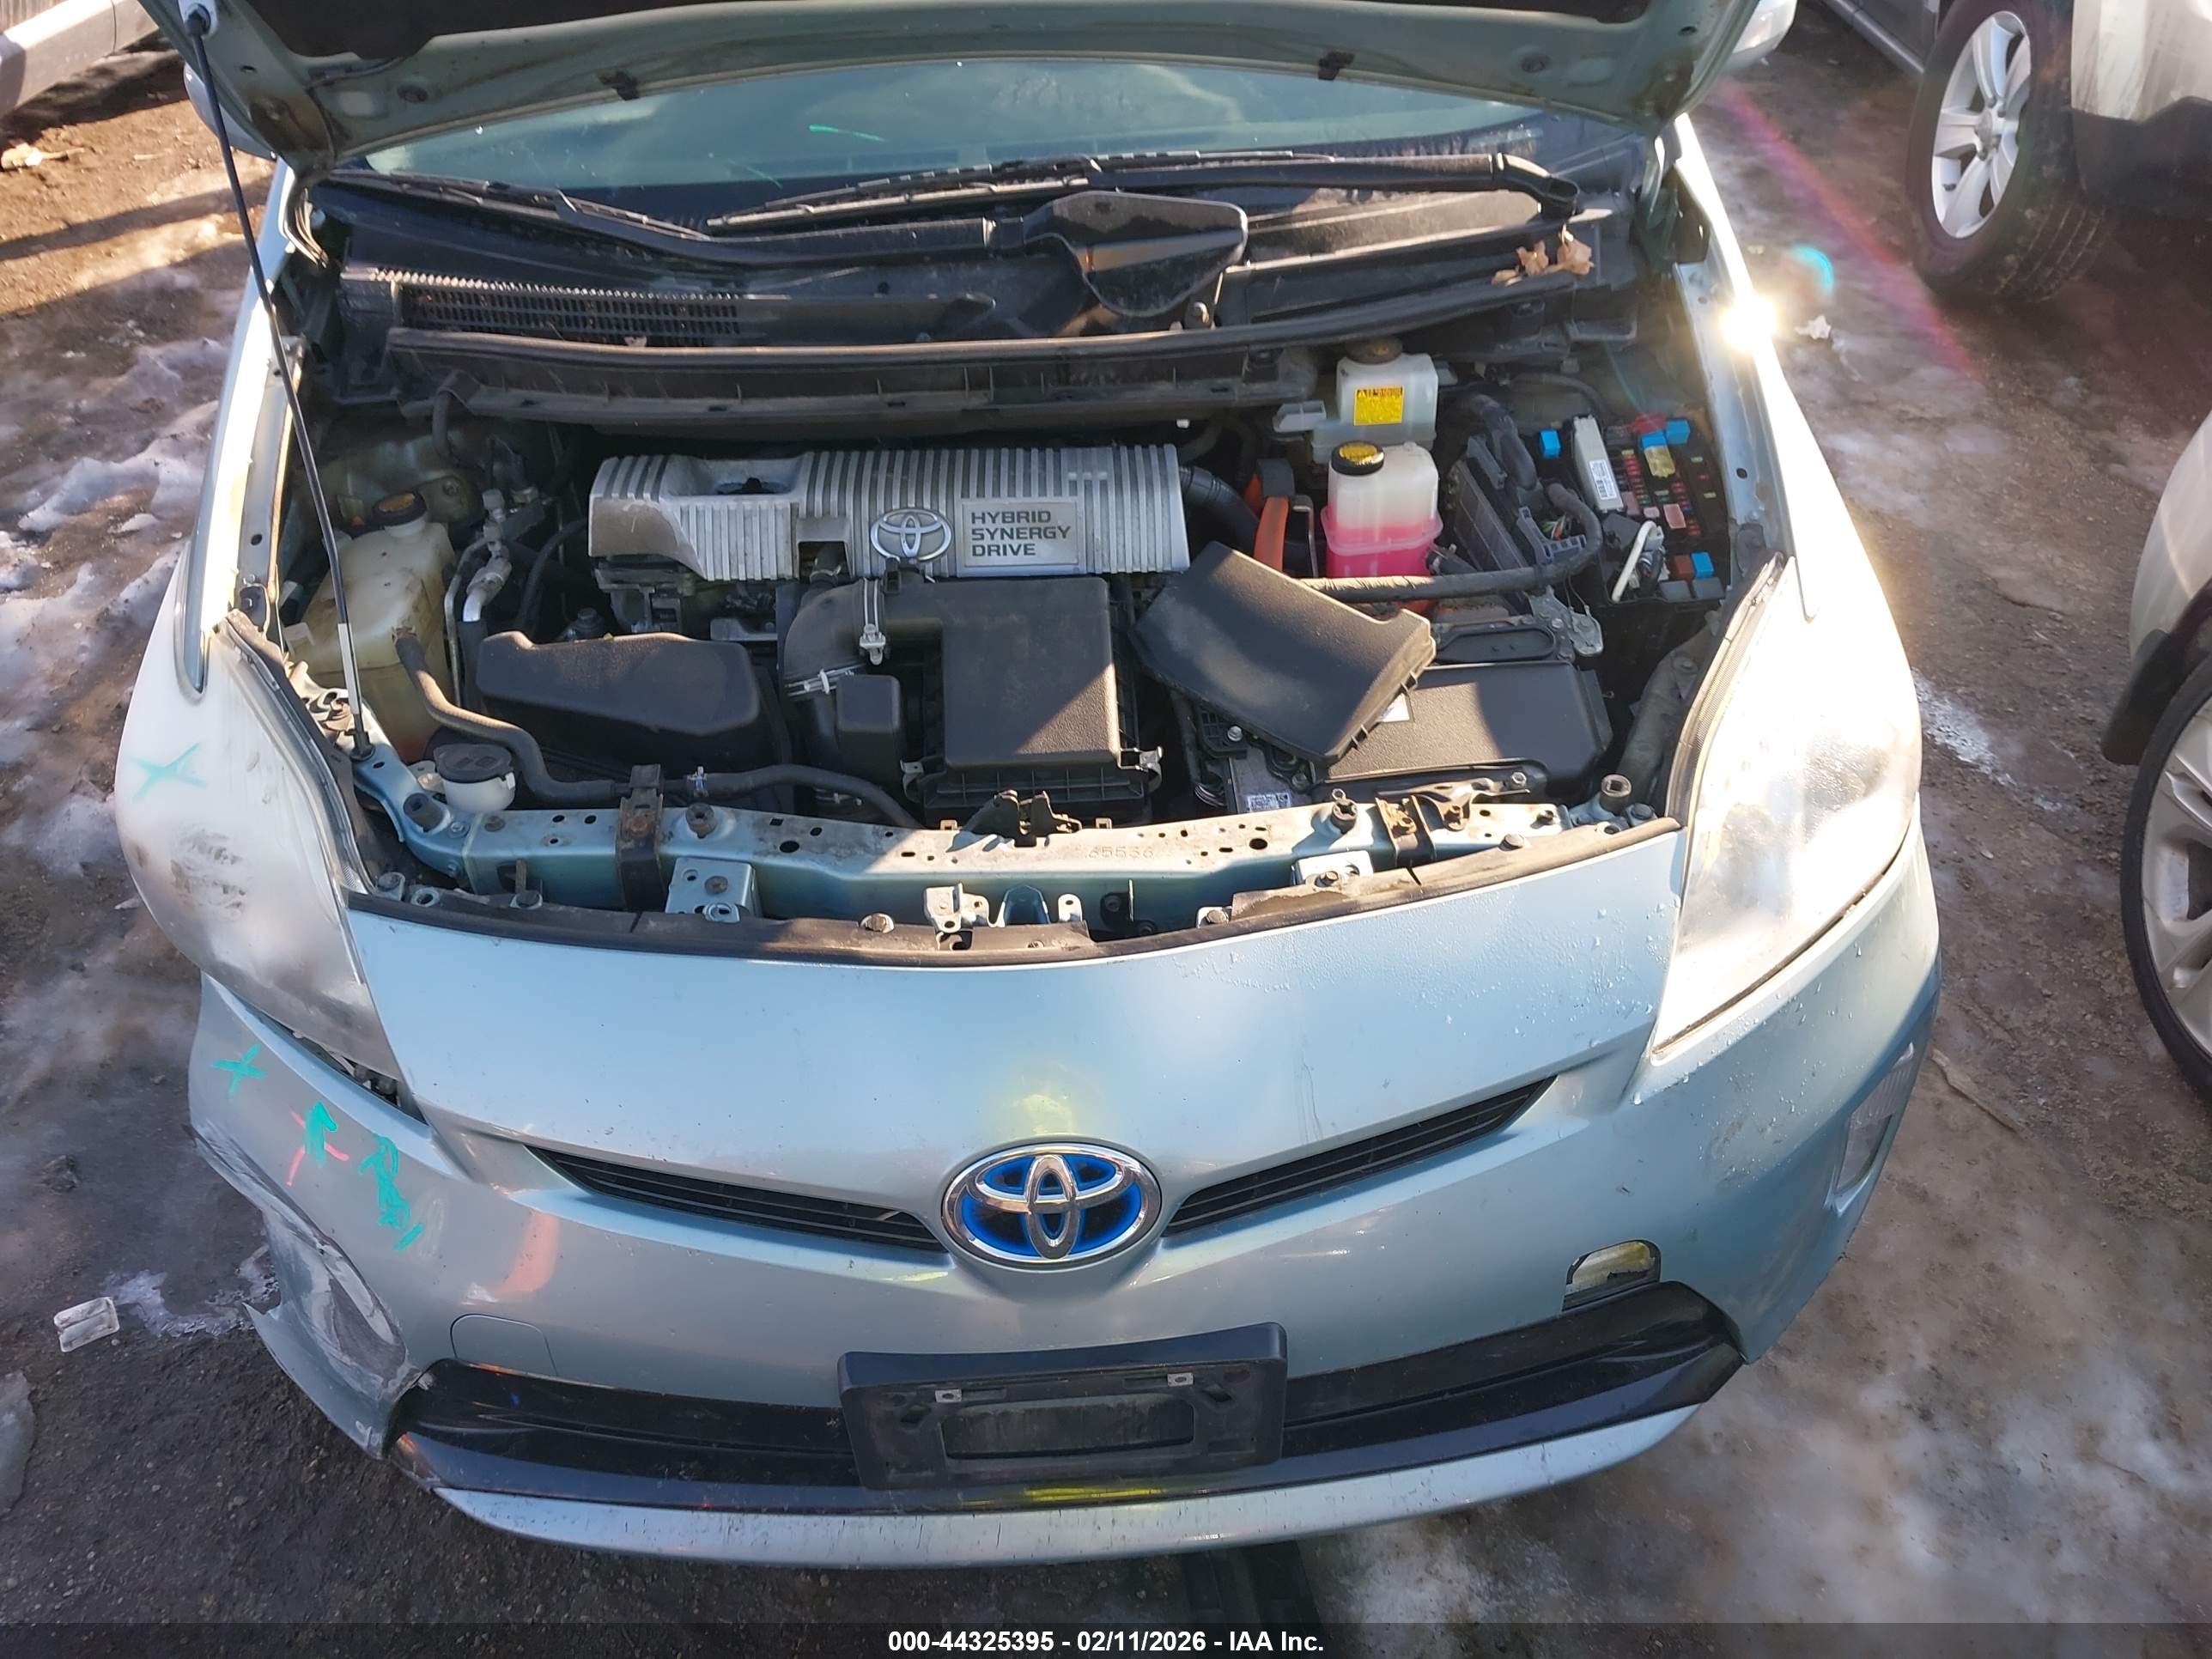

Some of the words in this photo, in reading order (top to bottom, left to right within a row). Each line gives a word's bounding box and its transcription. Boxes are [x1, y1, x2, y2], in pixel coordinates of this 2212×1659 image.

[971, 510, 1051, 525] HYBRID
[971, 526, 1071, 541] SYNERGY
[971, 543, 1036, 556] DRIVE
